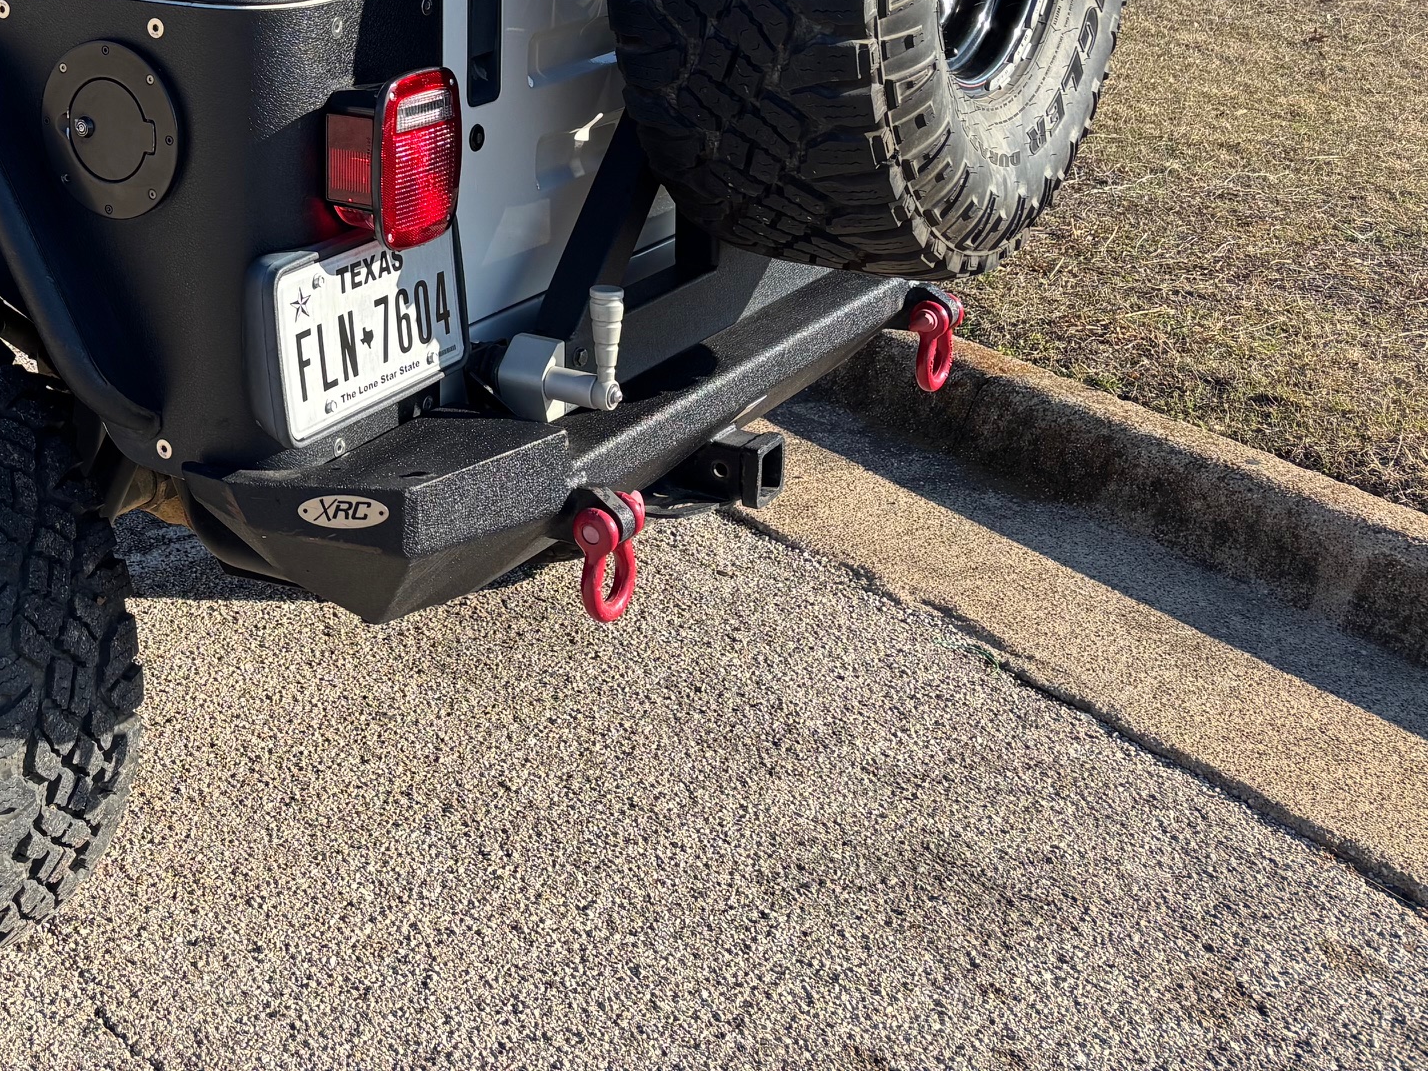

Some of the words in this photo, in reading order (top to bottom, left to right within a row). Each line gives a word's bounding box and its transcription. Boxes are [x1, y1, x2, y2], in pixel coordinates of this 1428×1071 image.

[336, 250, 404, 294] TEXAS
[295, 310, 360, 402] FLN
[374, 271, 451, 364] 7604
[340, 389, 357, 404] The
[358, 380, 379, 395] Lone
[380, 371, 398, 385] Star
[399, 359, 421, 376] State
[313, 498, 372, 522] XRC
